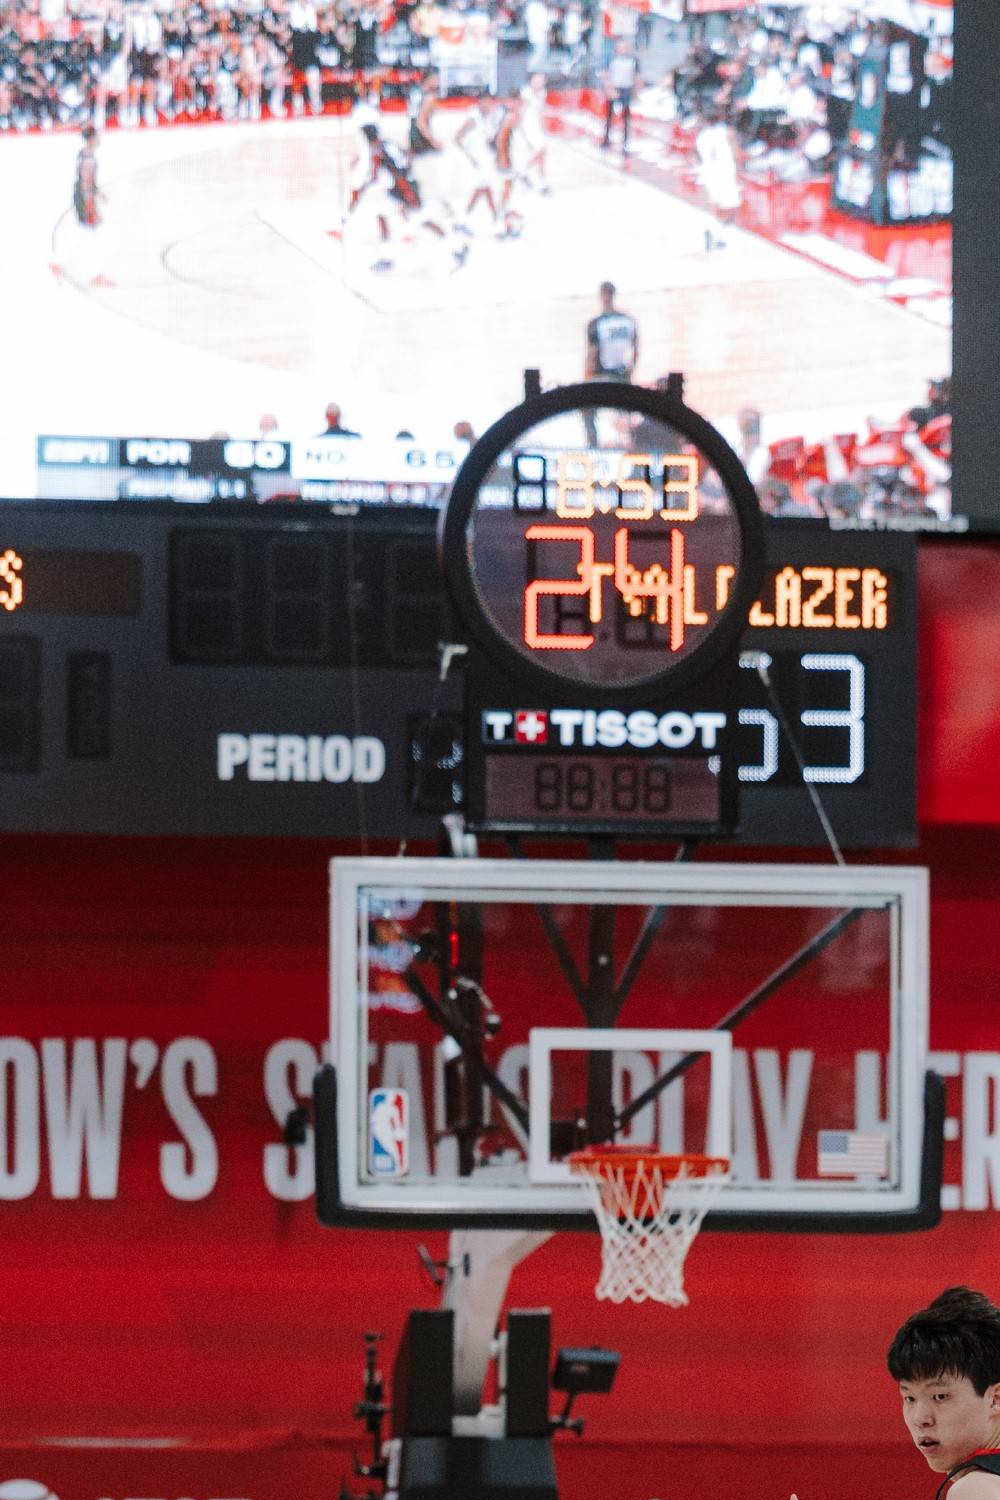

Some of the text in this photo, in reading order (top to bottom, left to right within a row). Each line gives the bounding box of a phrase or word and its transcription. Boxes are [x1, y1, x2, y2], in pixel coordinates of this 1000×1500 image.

[524, 525, 684, 652] 24
[550, 710, 727, 749] TISSOT
[217, 732, 386, 783] PERIOD
